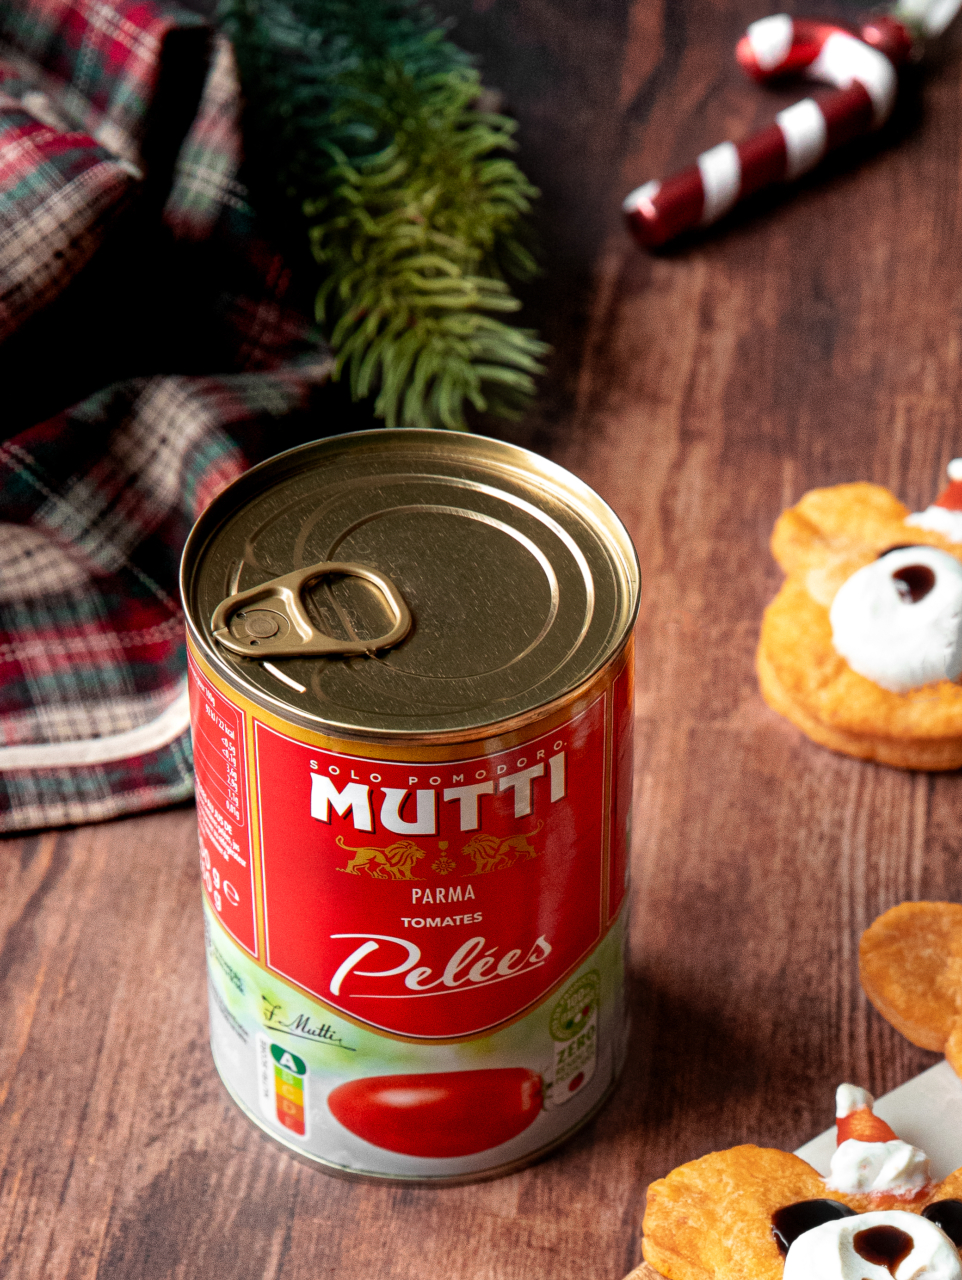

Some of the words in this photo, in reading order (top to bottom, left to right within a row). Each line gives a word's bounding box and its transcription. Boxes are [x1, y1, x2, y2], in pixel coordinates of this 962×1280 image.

[218, 718, 225, 731] 22
[225, 723, 235, 740] kcal
[309, 759, 382, 782] SOLO
[310, 751, 567, 836] MUTTI
[213, 808, 224, 826] JUS
[223, 820, 233, 835] DE
[212, 867, 221, 890] g
[213, 889, 222, 912] g
[411, 884, 476, 905] PARMA
[400, 911, 483, 928] TOMATES
[329, 933, 553, 996] Pelées
[556, 1024, 596, 1066] ZERO
[279, 1052, 298, 1073] A
[282, 1069, 294, 1084] B
[282, 1084, 295, 1099] C
[283, 1099, 297, 1114] D
